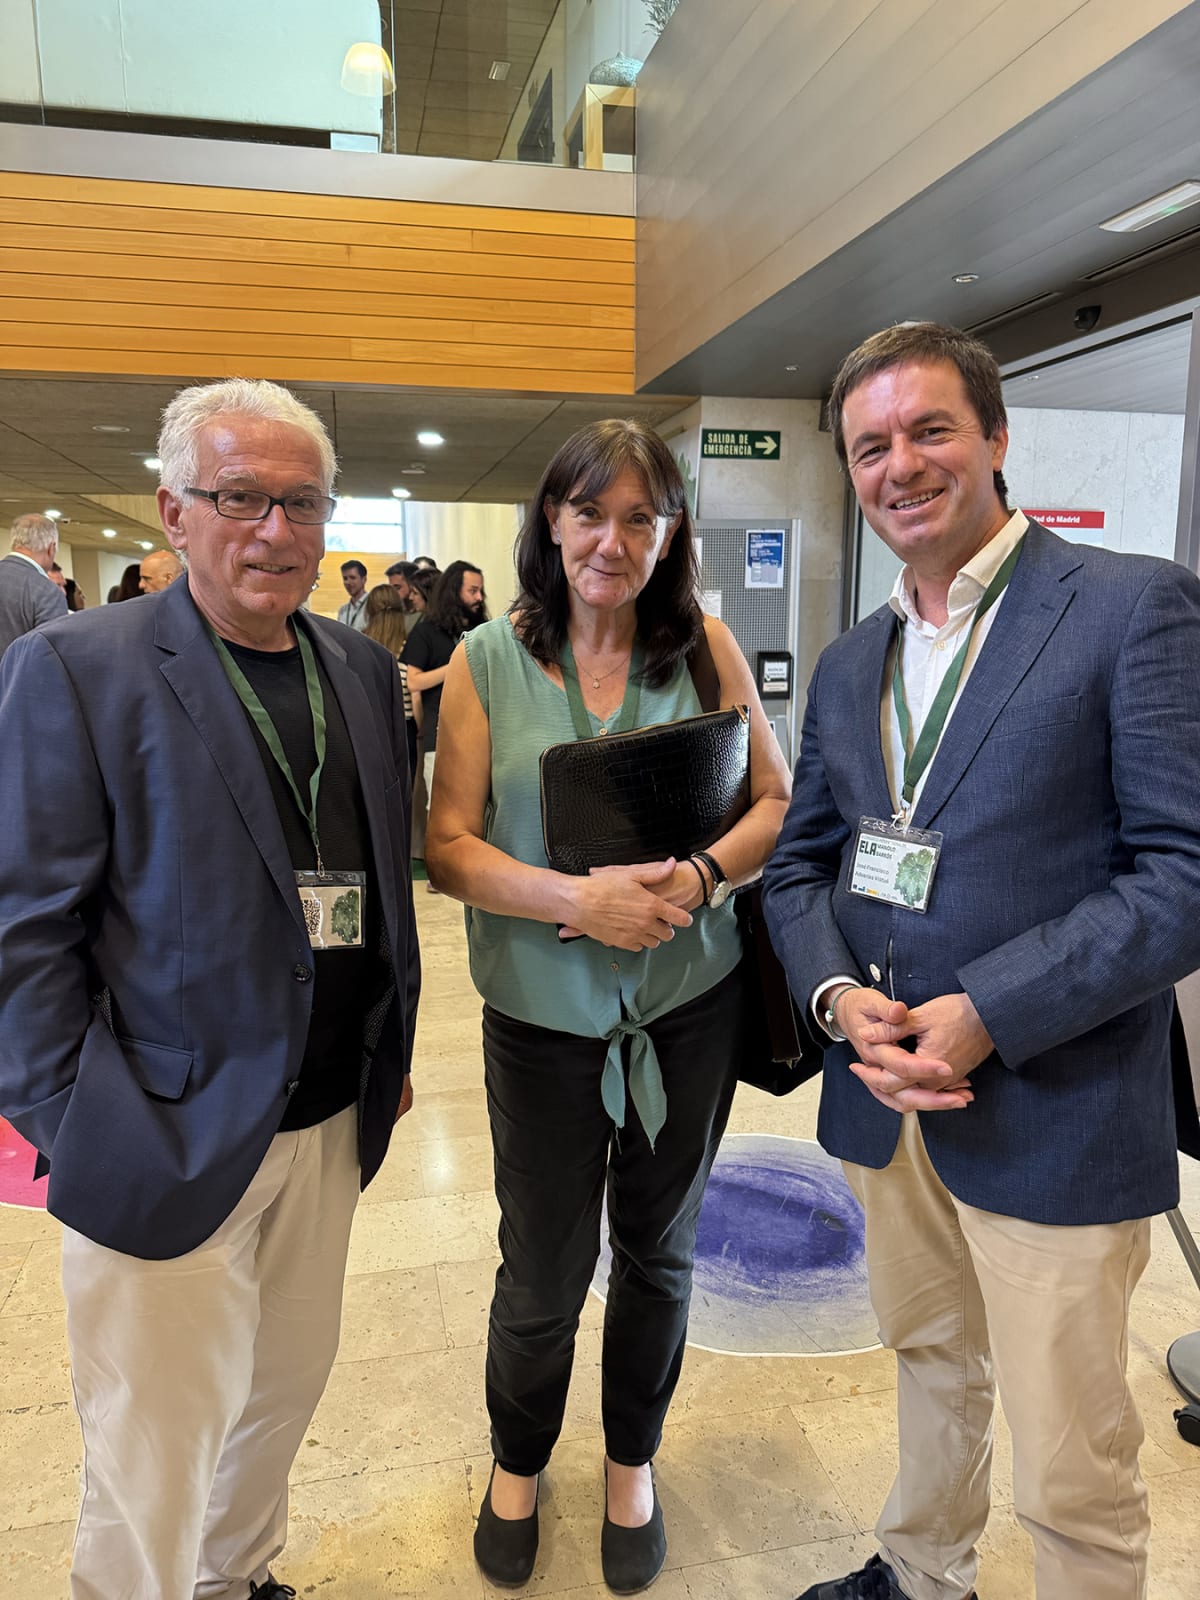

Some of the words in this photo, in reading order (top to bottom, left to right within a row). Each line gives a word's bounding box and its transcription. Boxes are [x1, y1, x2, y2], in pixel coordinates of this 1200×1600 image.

[707, 433, 736, 444] SALIDA
[739, 433, 749, 444] DE
[703, 444, 752, 456] EMERGENCIA
[1056, 515, 1080, 523] Madrid
[858, 840, 877, 856] ELA
